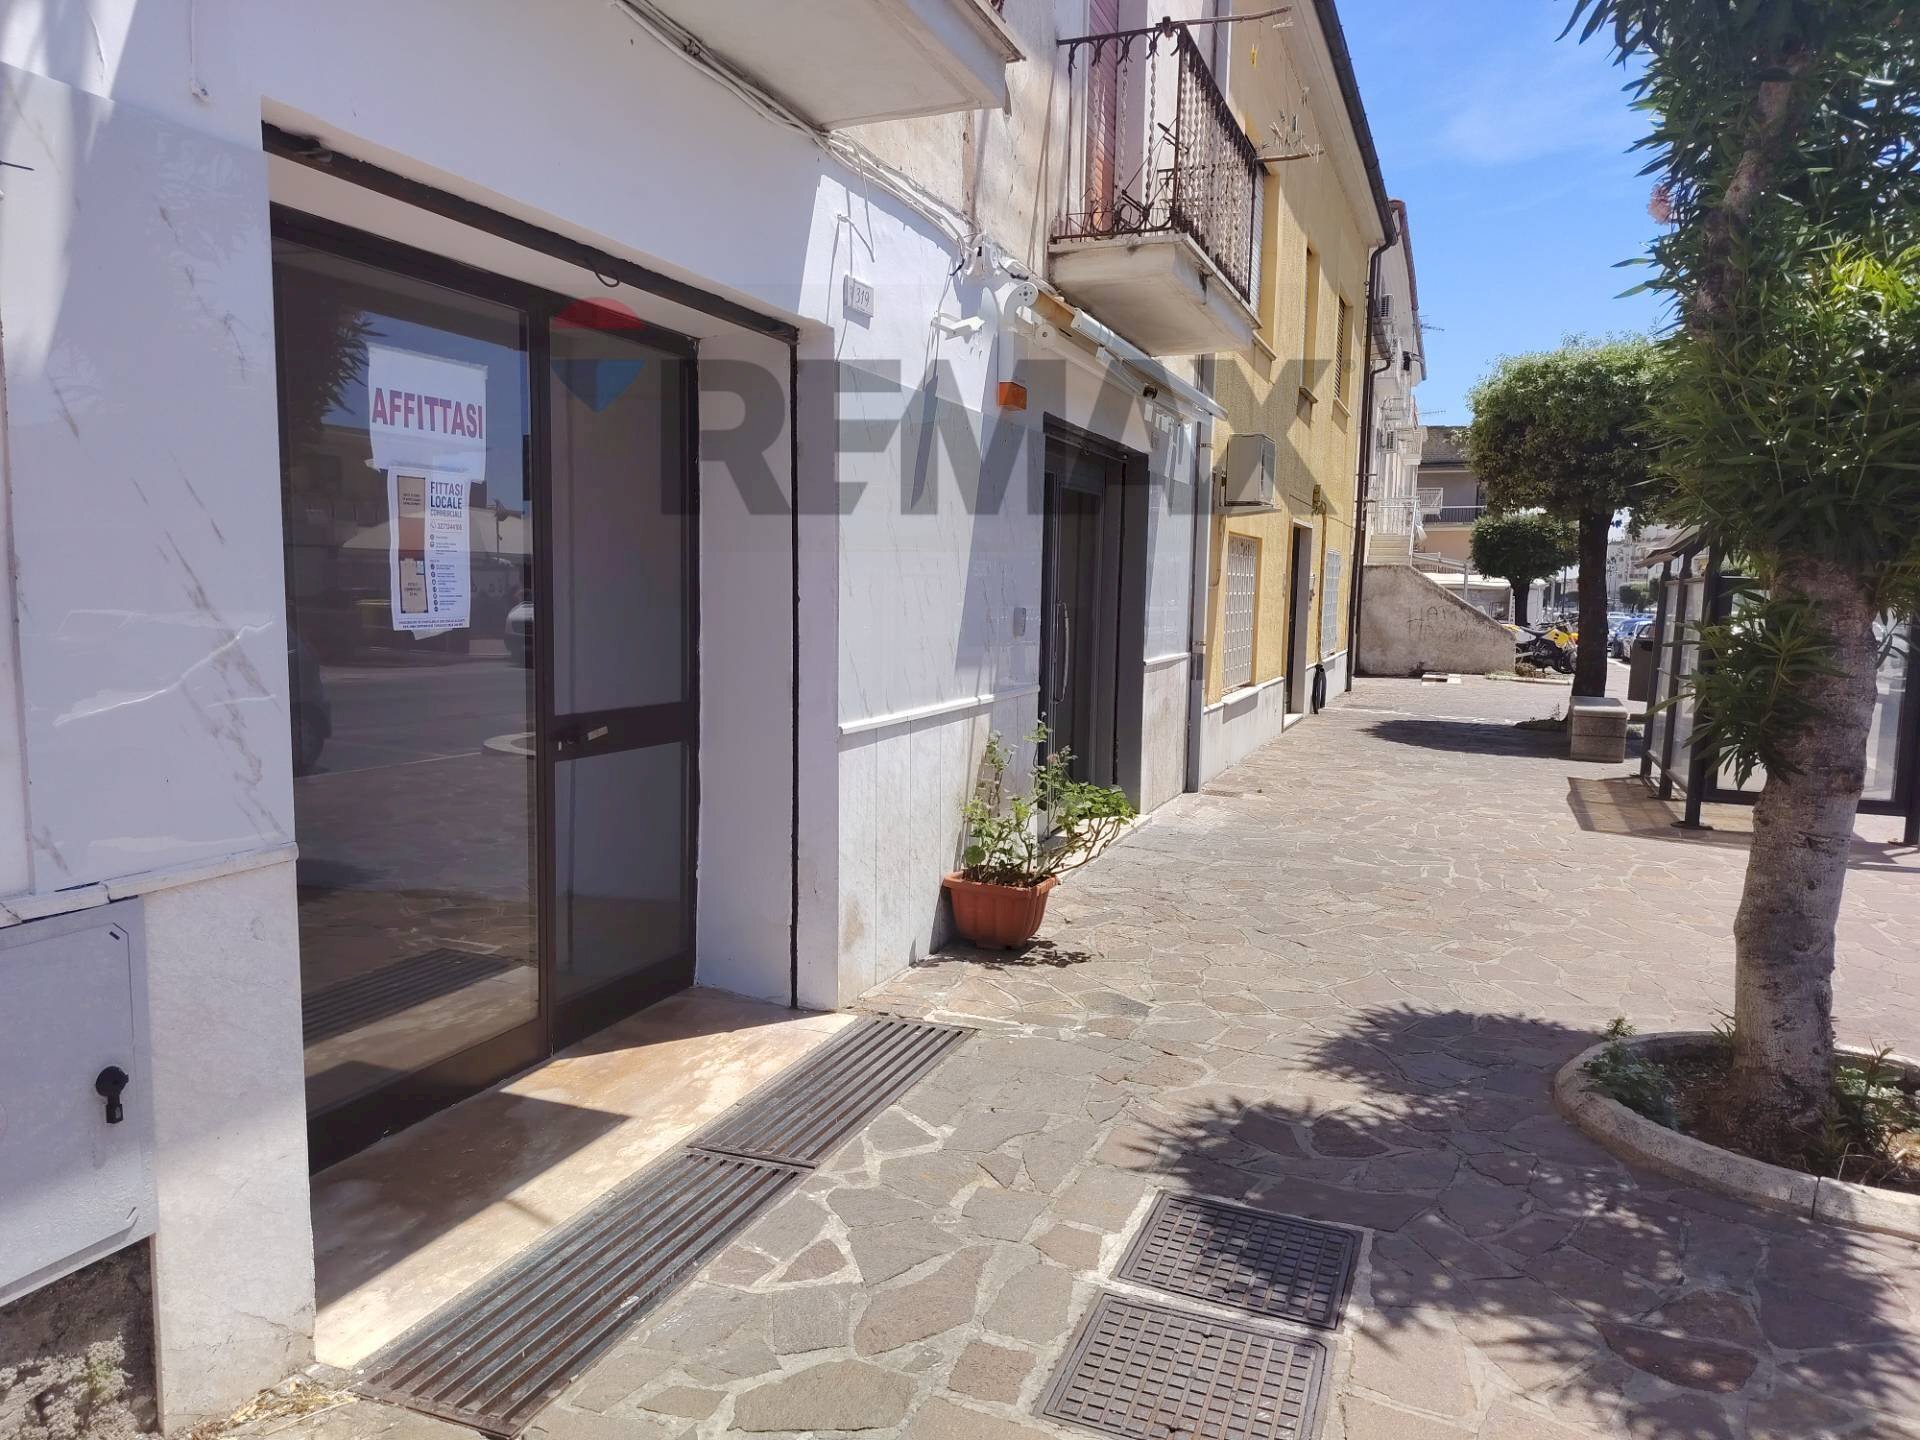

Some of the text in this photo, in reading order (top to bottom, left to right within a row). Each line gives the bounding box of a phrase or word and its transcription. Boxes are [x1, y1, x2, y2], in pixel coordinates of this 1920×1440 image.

[855, 287, 870, 307] 319
[371, 387, 483, 440] AFFITTASI
[430, 481, 463, 496] FITTASI
[430, 495, 462, 510] LOCALE
